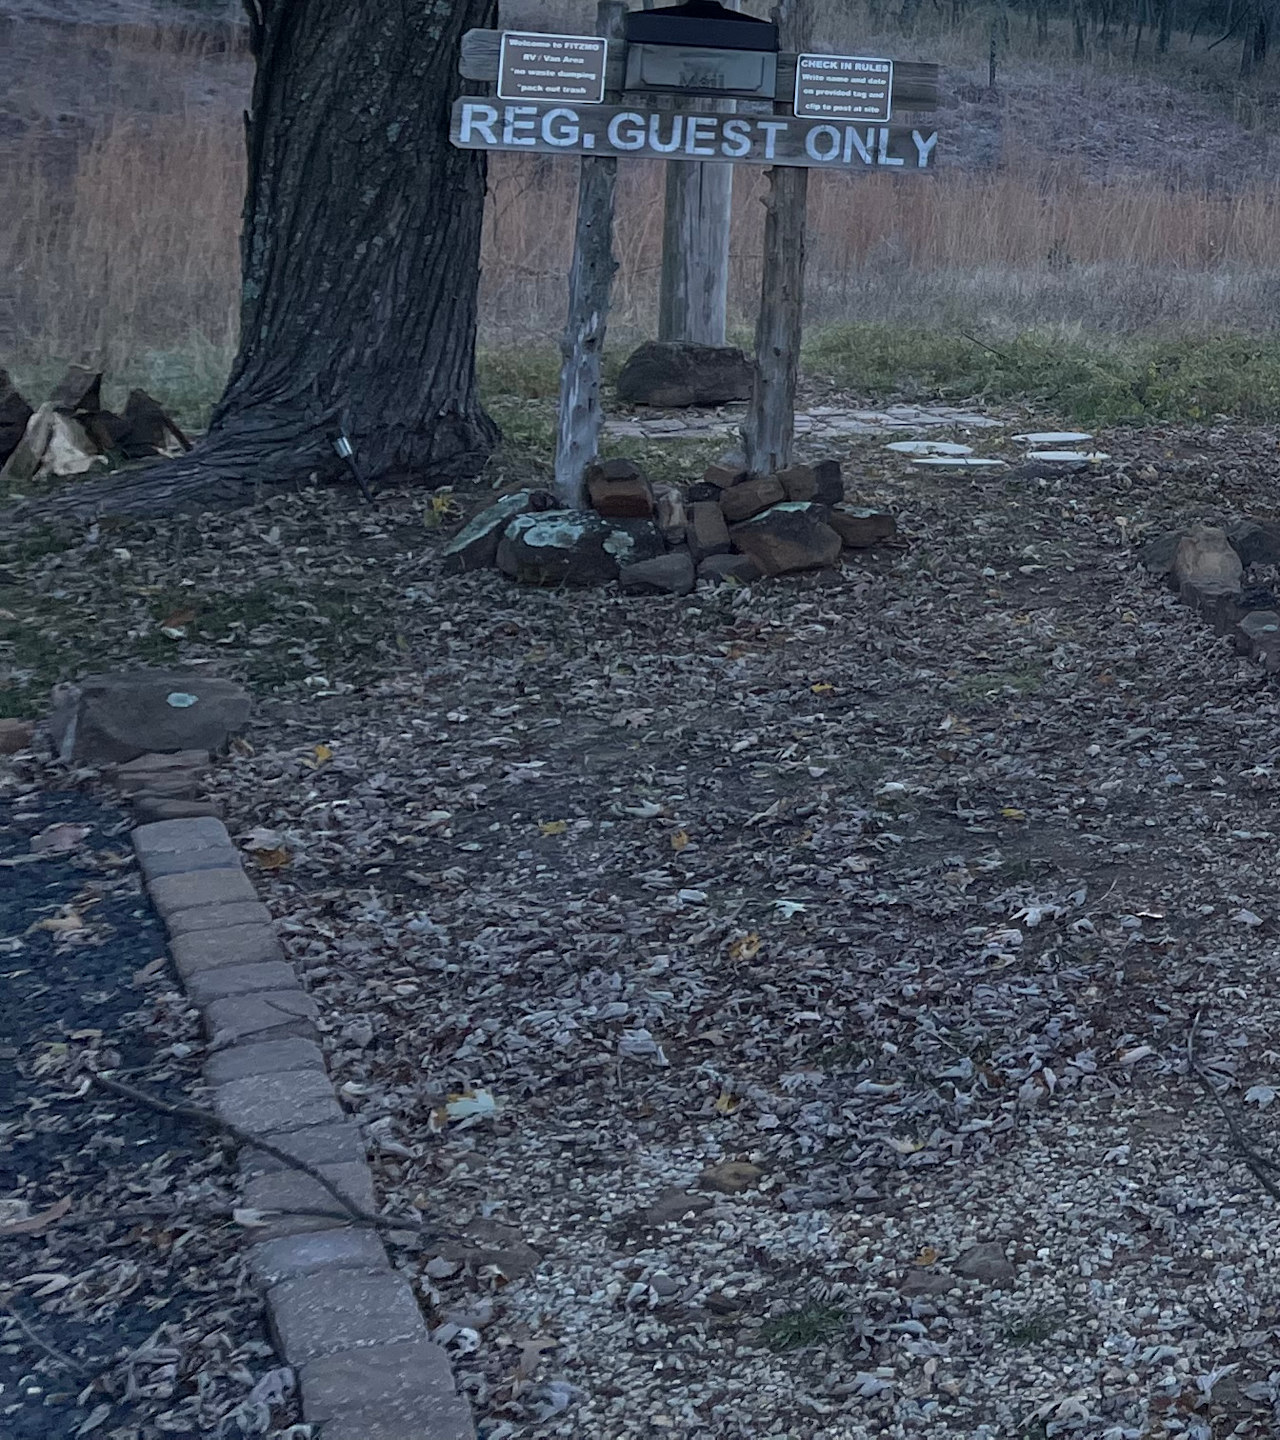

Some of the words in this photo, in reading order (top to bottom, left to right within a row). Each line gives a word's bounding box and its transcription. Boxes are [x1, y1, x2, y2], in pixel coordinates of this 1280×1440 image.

[523, 53, 536, 61] RV
[543, 55, 561, 63] Van
[562, 56, 584, 64] Area
[801, 59, 838, 69] CHECK
[840, 62, 852, 70] IN
[854, 63, 889, 72] RULES
[557, 71, 596, 80] dumping
[801, 73, 824, 81] Write
[562, 86, 587, 94] trash
[815, 89, 851, 97] provided
[852, 90, 867, 99] tag
[805, 103, 821, 111] clip
[833, 104, 852, 112] post
[459, 103, 595, 148] REG.
[607, 112, 788, 159] GUEST
[805, 125, 938, 168] ONLY
